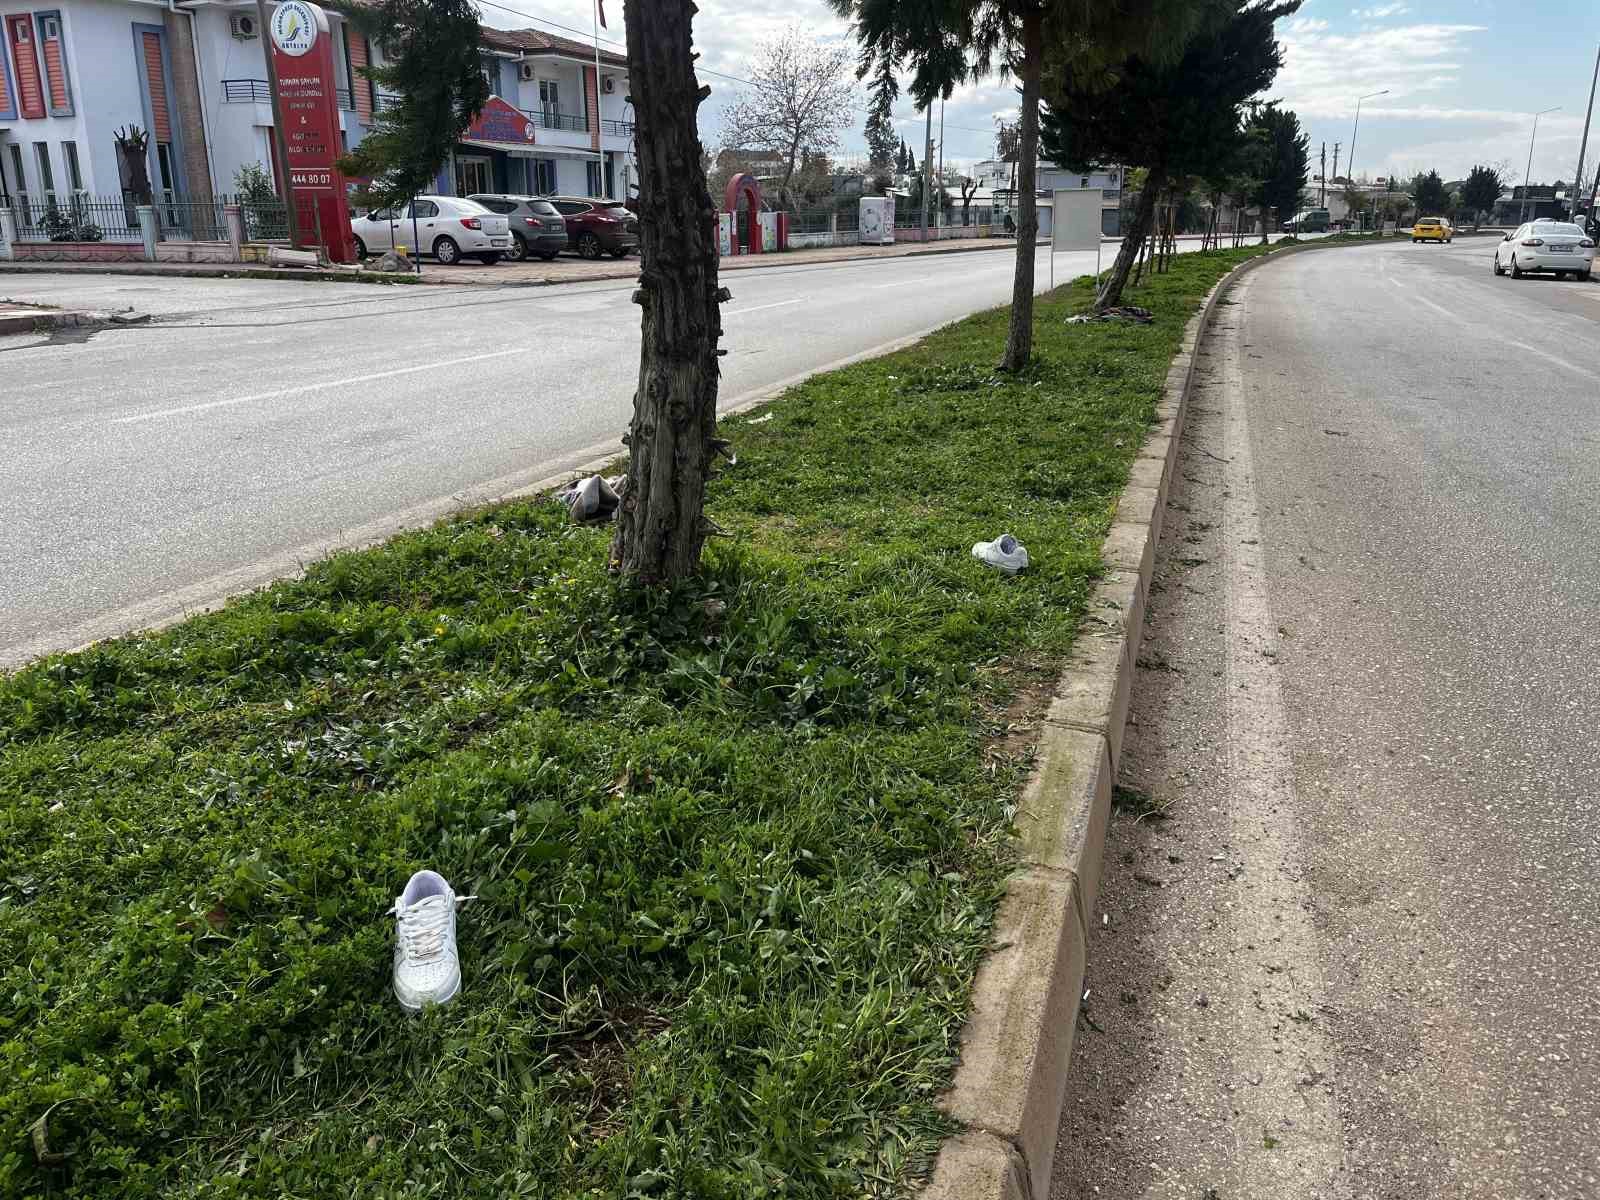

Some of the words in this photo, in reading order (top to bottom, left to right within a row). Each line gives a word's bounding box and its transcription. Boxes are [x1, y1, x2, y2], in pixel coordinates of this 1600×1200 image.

[292, 174, 307, 184] 444
[309, 174, 319, 184] 80
[320, 174, 330, 184] 07
